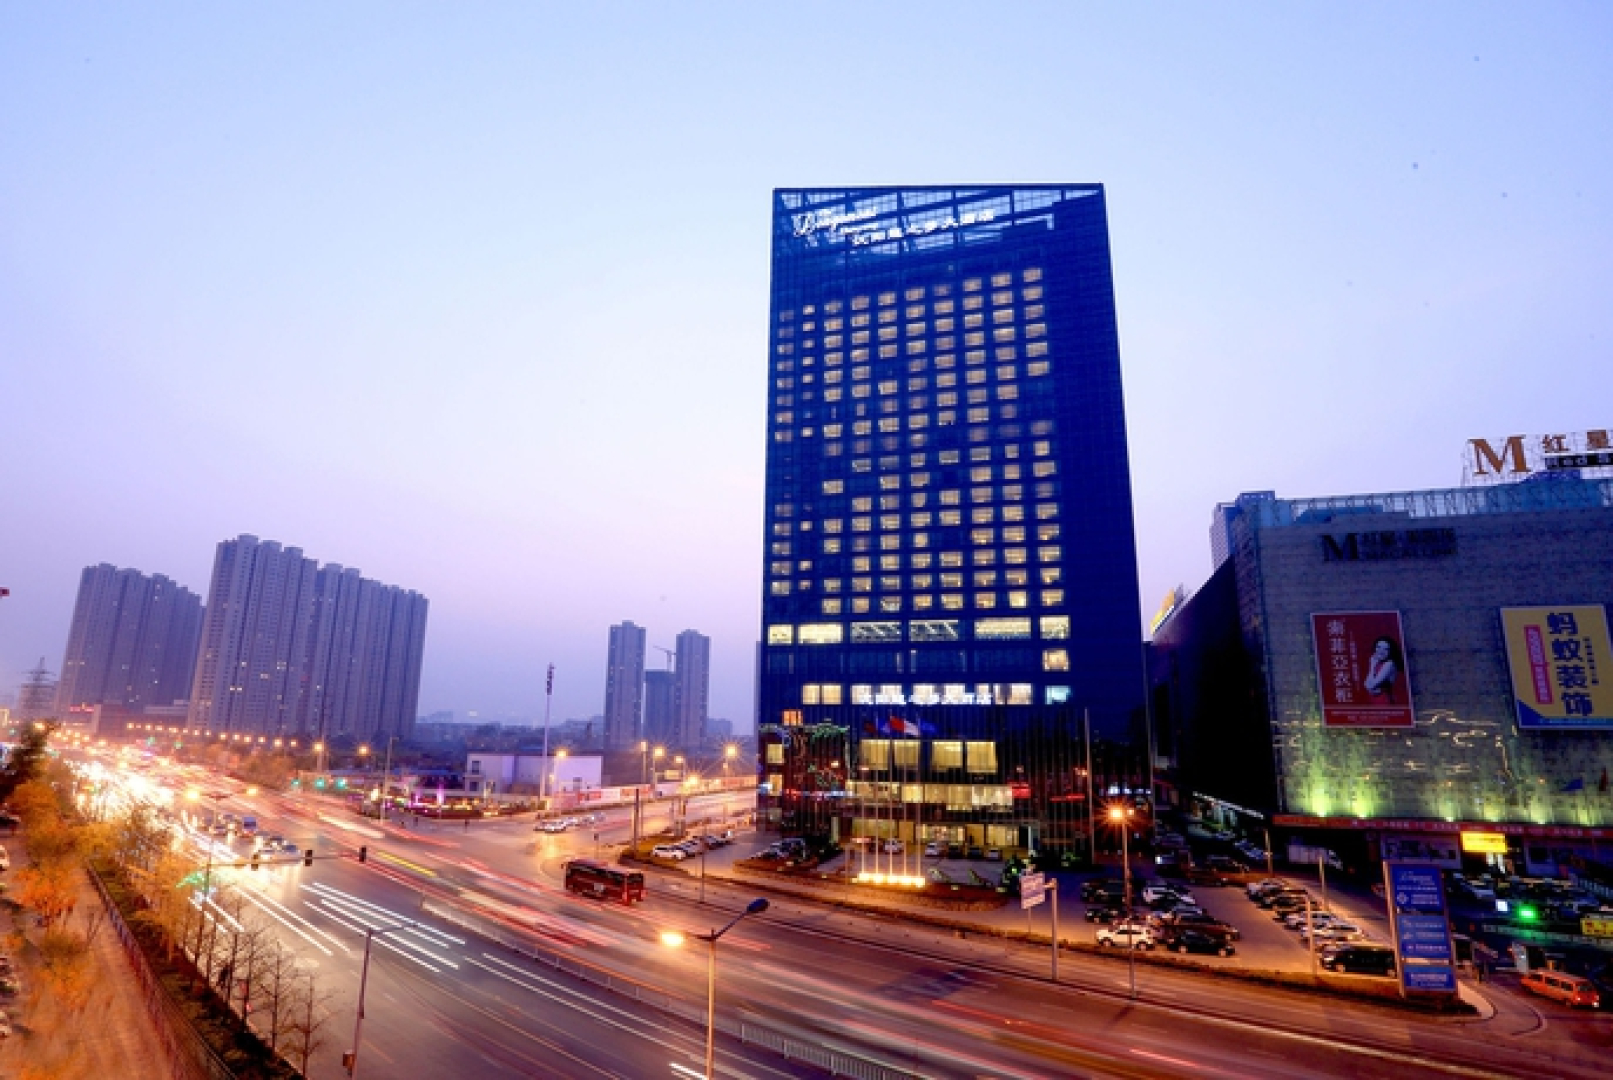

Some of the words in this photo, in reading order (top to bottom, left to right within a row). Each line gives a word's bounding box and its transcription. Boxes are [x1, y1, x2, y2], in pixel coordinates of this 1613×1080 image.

[1467, 436, 1531, 475] M
[1319, 532, 1359, 562] M
[1546, 612, 1594, 716] 蚂蚁装饰
